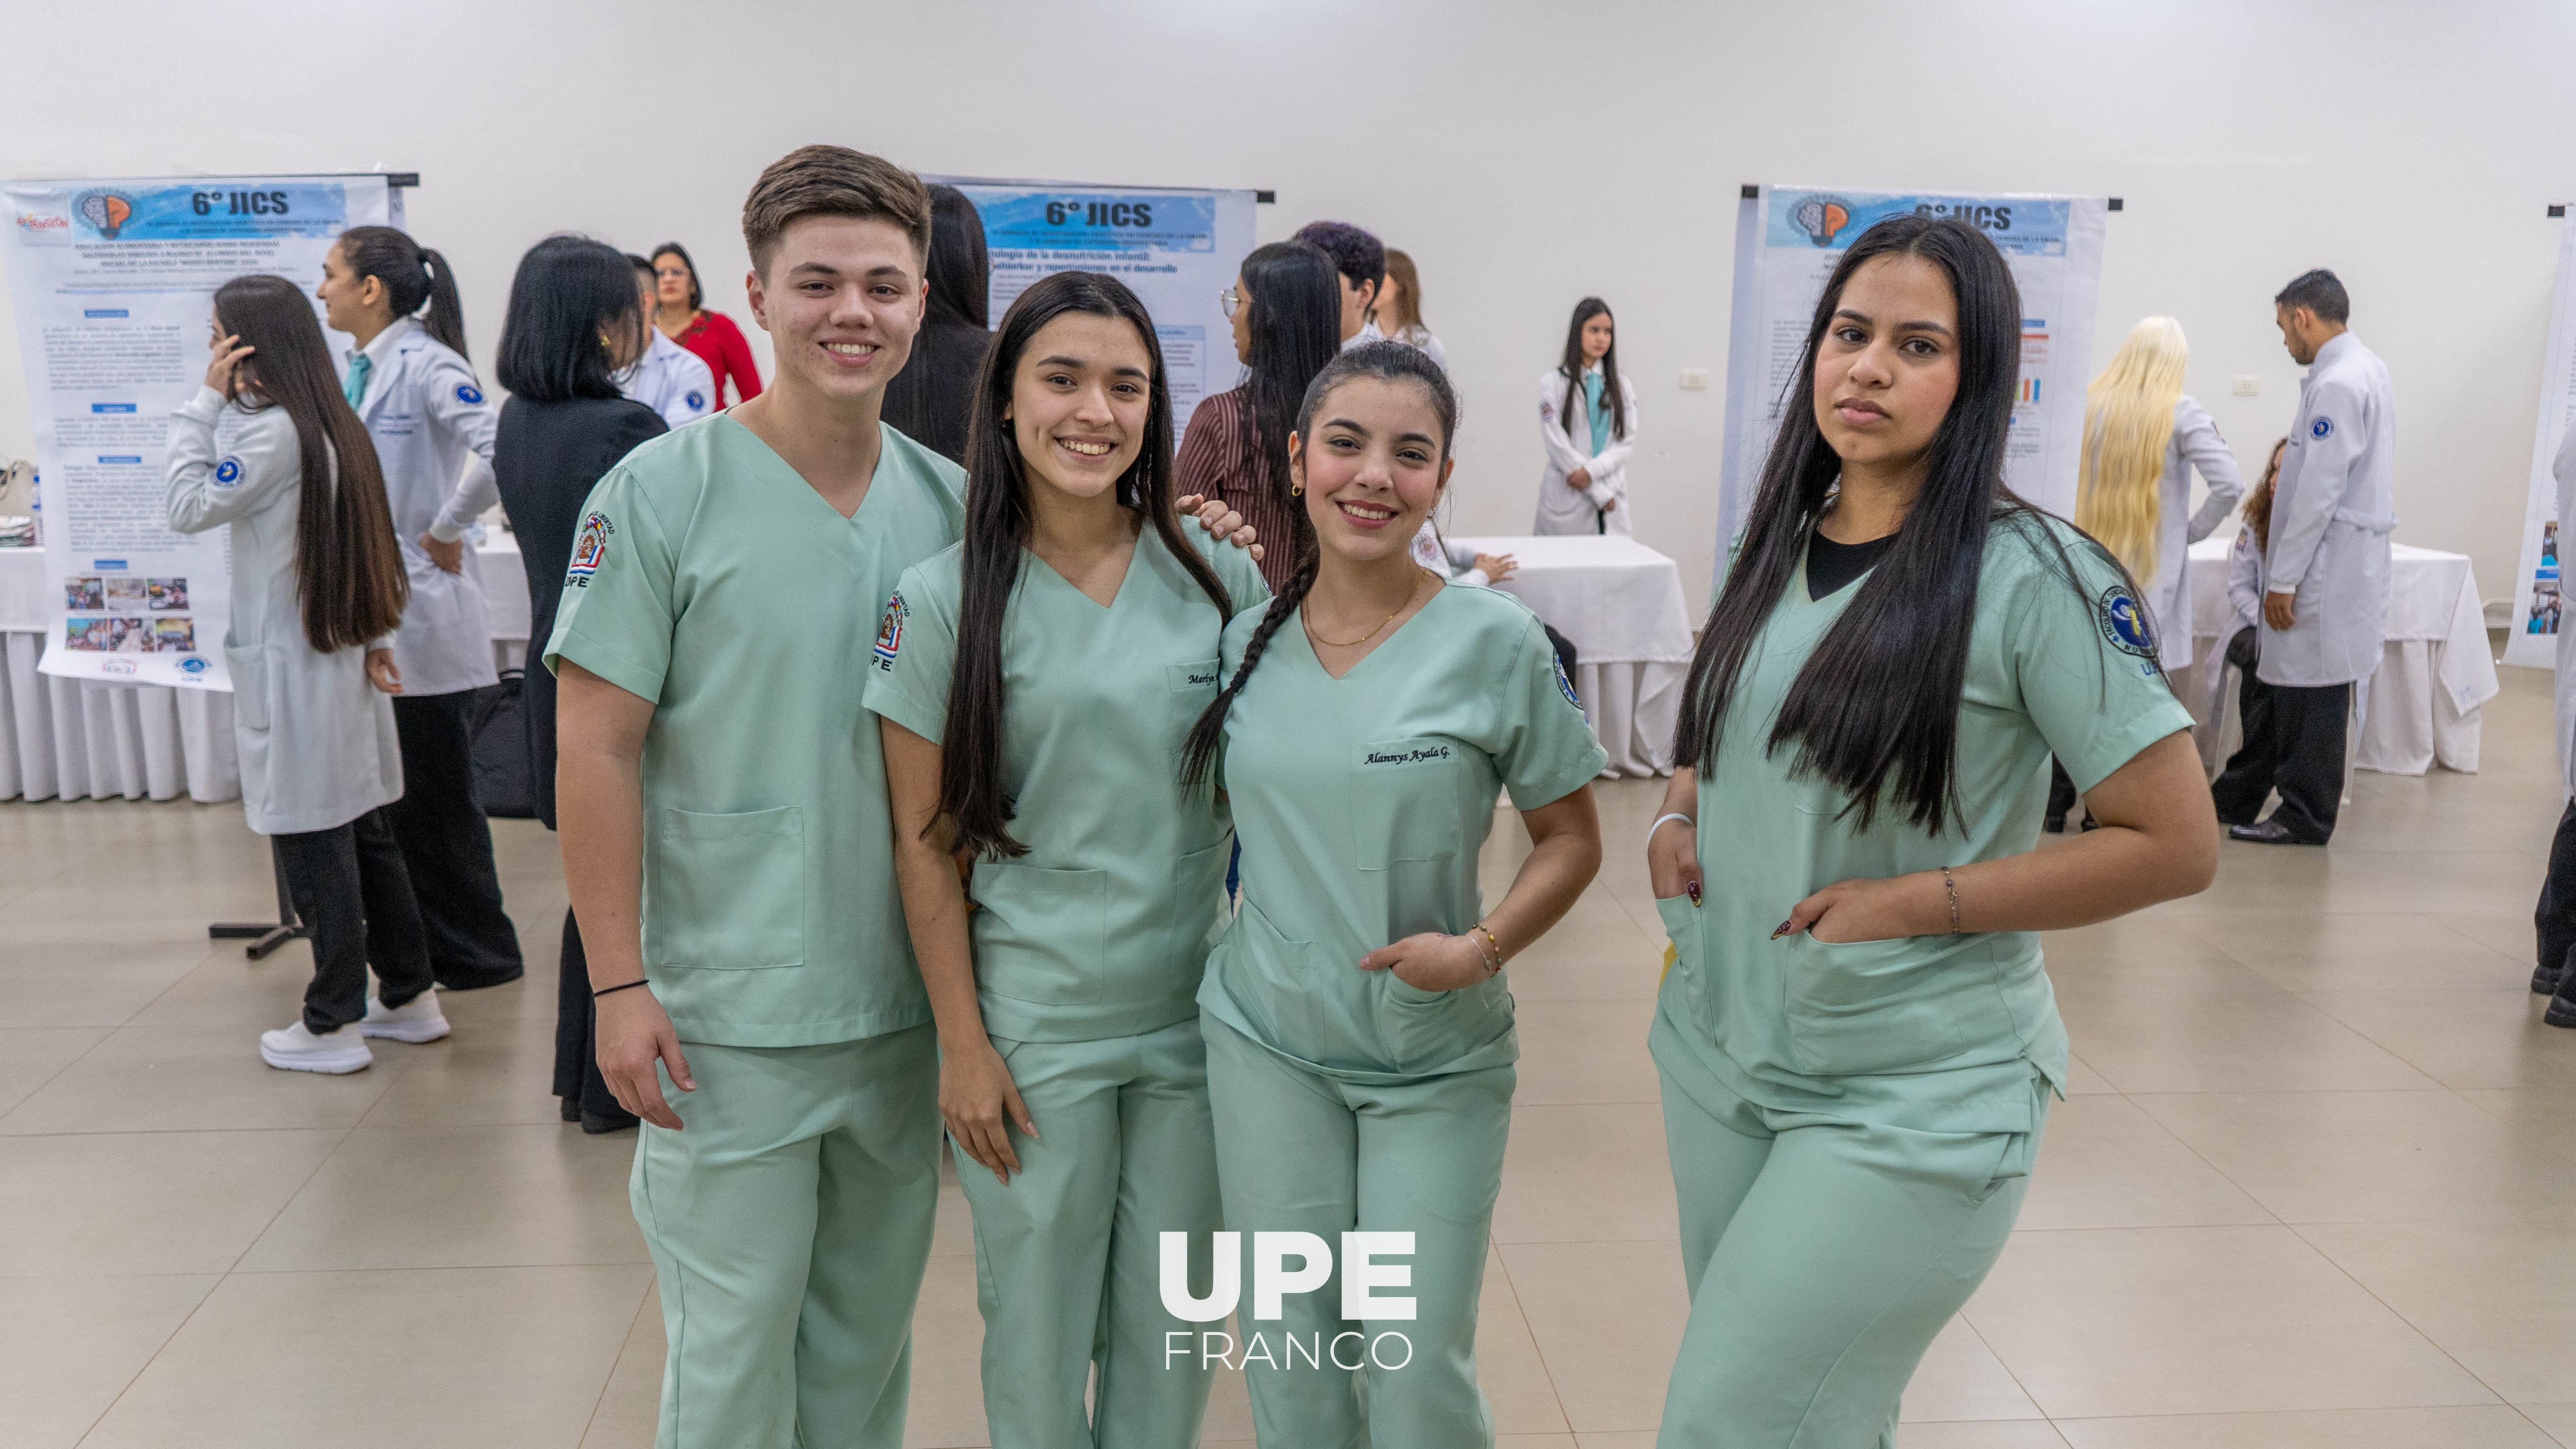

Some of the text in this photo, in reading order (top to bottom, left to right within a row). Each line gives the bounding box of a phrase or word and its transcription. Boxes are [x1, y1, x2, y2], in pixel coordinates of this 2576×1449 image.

[229, 191, 289, 215] JICS
[1086, 202, 1152, 228] JICS
[989, 250, 1023, 260] tología
[1027, 250, 1039, 259] de
[1041, 251, 1049, 259] la
[1134, 264, 1178, 274] desarrollo
[871, 654, 893, 672] PE
[1364, 746, 1450, 764] Alannys Ayala G.
